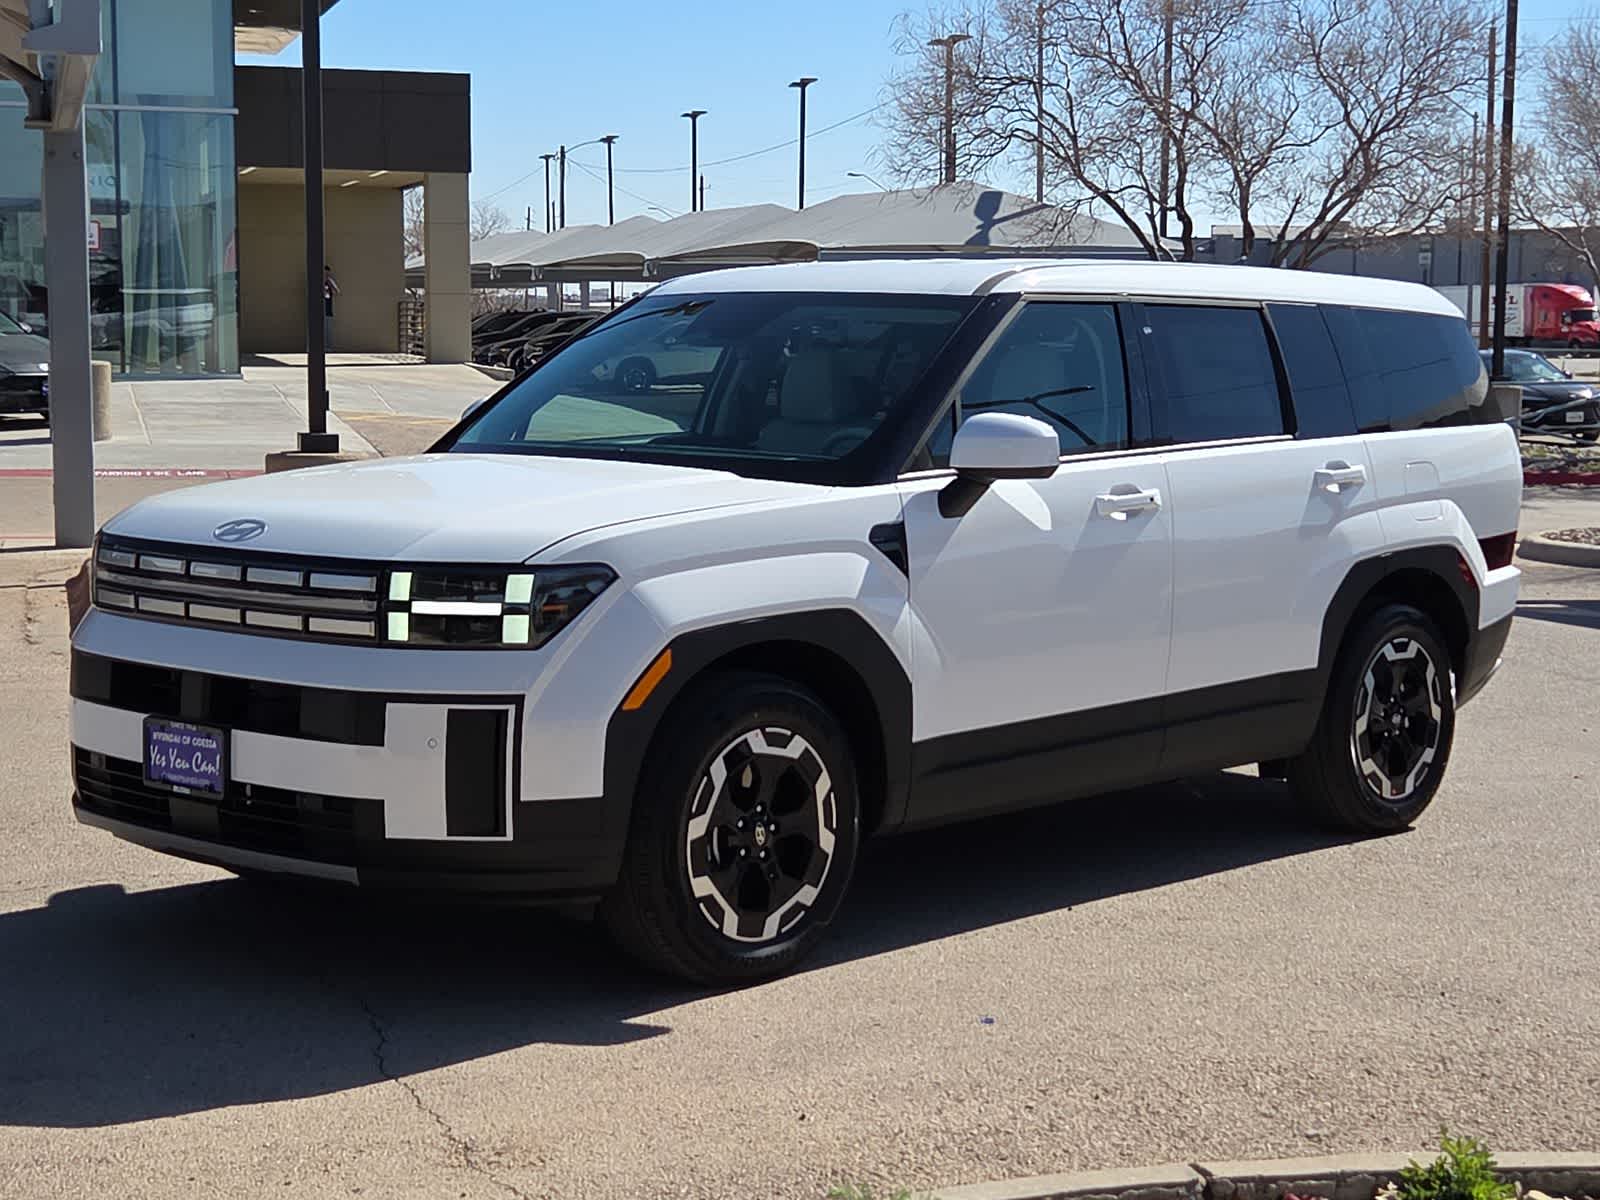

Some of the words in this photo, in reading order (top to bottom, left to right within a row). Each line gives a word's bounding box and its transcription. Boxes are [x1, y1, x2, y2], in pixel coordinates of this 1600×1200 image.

[150, 744, 167, 768] Yes
[169, 747, 190, 769] You
[192, 751, 220, 776] Can!
